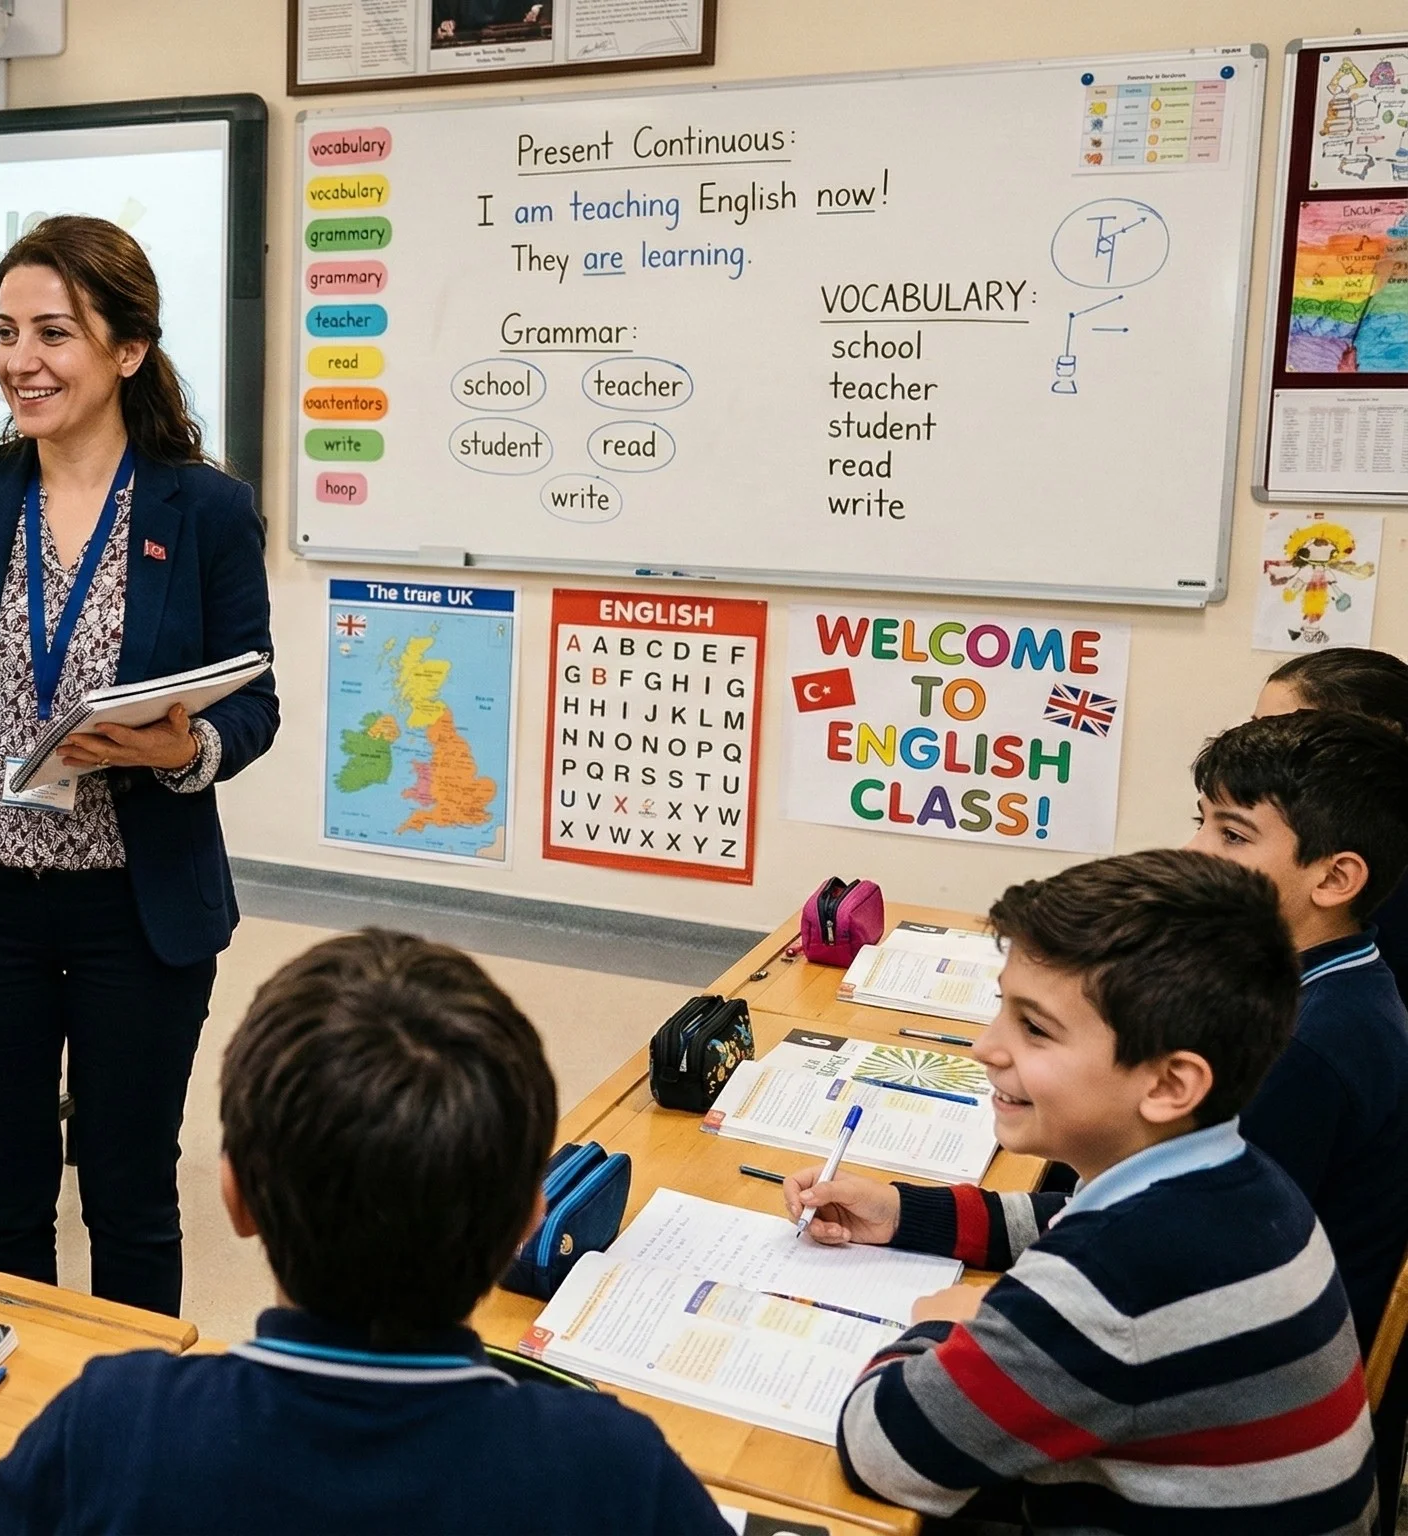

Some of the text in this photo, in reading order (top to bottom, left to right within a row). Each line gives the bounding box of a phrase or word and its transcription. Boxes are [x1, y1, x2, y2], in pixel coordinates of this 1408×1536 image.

[312, 138, 386, 161] vocabulary
[518, 126, 796, 168] Present Continuous:
[310, 183, 384, 206] vocabulary
[478, 195, 494, 226] I
[514, 203, 553, 224] am
[570, 190, 680, 231] teaching
[700, 182, 796, 225] English
[310, 225, 386, 249] grammary
[512, 241, 752, 283] They are learning.
[310, 270, 383, 290] grammary
[821, 279, 1037, 314] VOCABULARY:
[315, 313, 371, 329] teacher
[501, 313, 637, 346] Grammar:
[831, 331, 922, 361] school
[328, 354, 359, 369] read
[463, 373, 683, 398] school teacher
[830, 373, 938, 402] teacher
[828, 412, 936, 442] student
[324, 437, 361, 452] write
[460, 432, 656, 459] student read
[828, 451, 892, 480] read
[325, 481, 357, 500] hoop
[551, 485, 610, 512] write
[828, 492, 906, 521] write
[366, 584, 397, 600] The
[448, 590, 473, 606] UK
[600, 599, 714, 627] ENGLISH
[566, 634, 745, 664] A A B C D E F
[816, 614, 1101, 675] WELCOME
[565, 666, 744, 698] G B F G H I G
[910, 675, 987, 721] TO
[564, 697, 744, 730] H H I J K L M
[563, 728, 742, 763] N N O N O P Q
[827, 721, 1071, 783] ENGLISH
[562, 759, 739, 794] P Q R S S T U
[561, 790, 741, 826] U V X X Y W
[850, 778, 1050, 840] CLASS!
[560, 820, 736, 857] X V W X X Y Z
